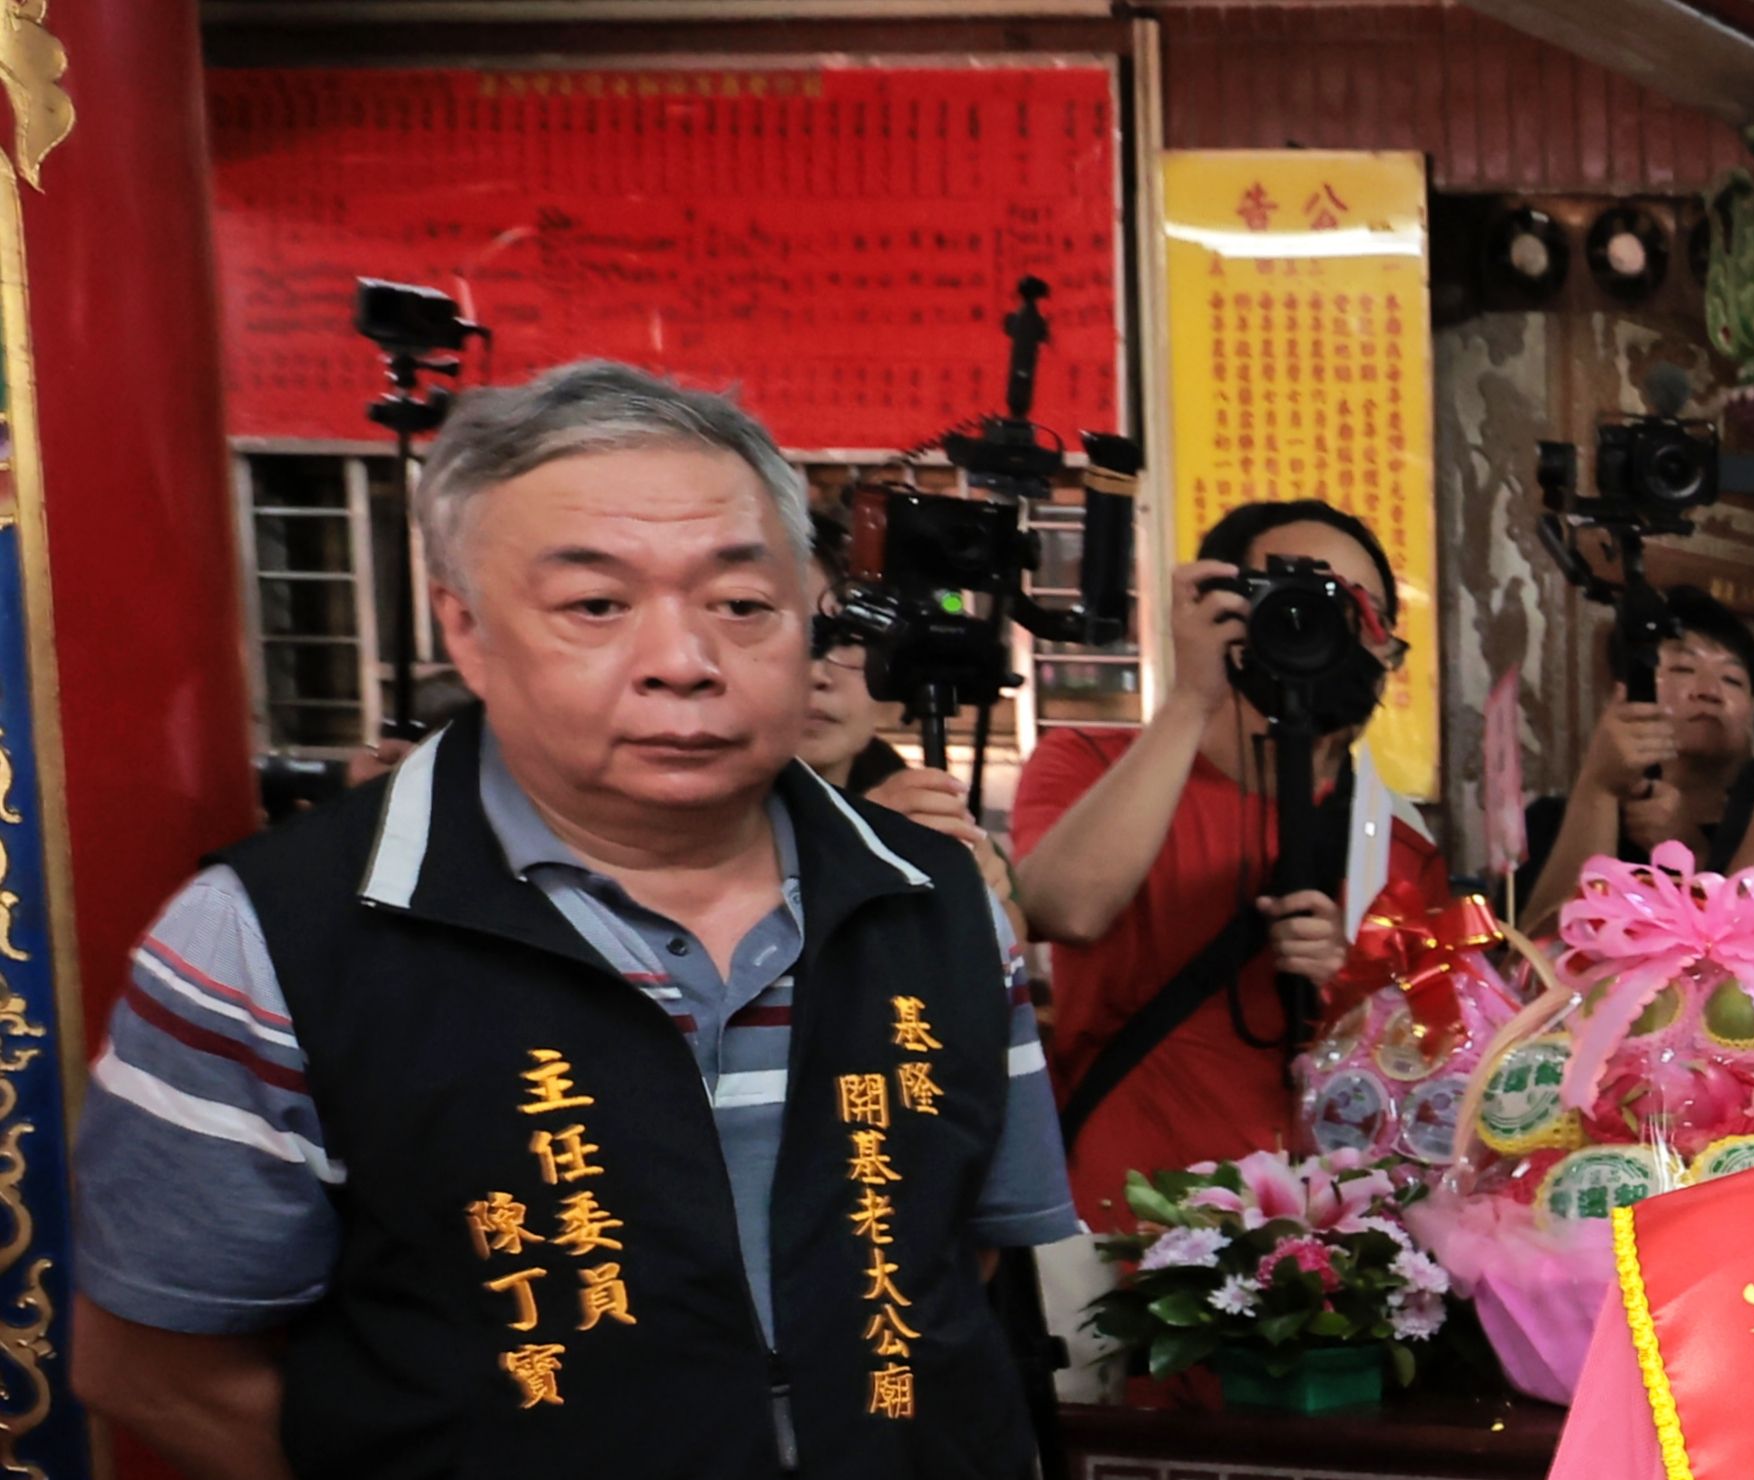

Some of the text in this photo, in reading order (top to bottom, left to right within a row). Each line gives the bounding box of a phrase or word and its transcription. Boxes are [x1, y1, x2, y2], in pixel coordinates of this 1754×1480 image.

[889, 995, 944, 1115] 基隆
[465, 1191, 565, 1408] 陳丁寶
[516, 1048, 637, 1331] 主任委員
[835, 1073, 921, 1419] 開基老大公廟
